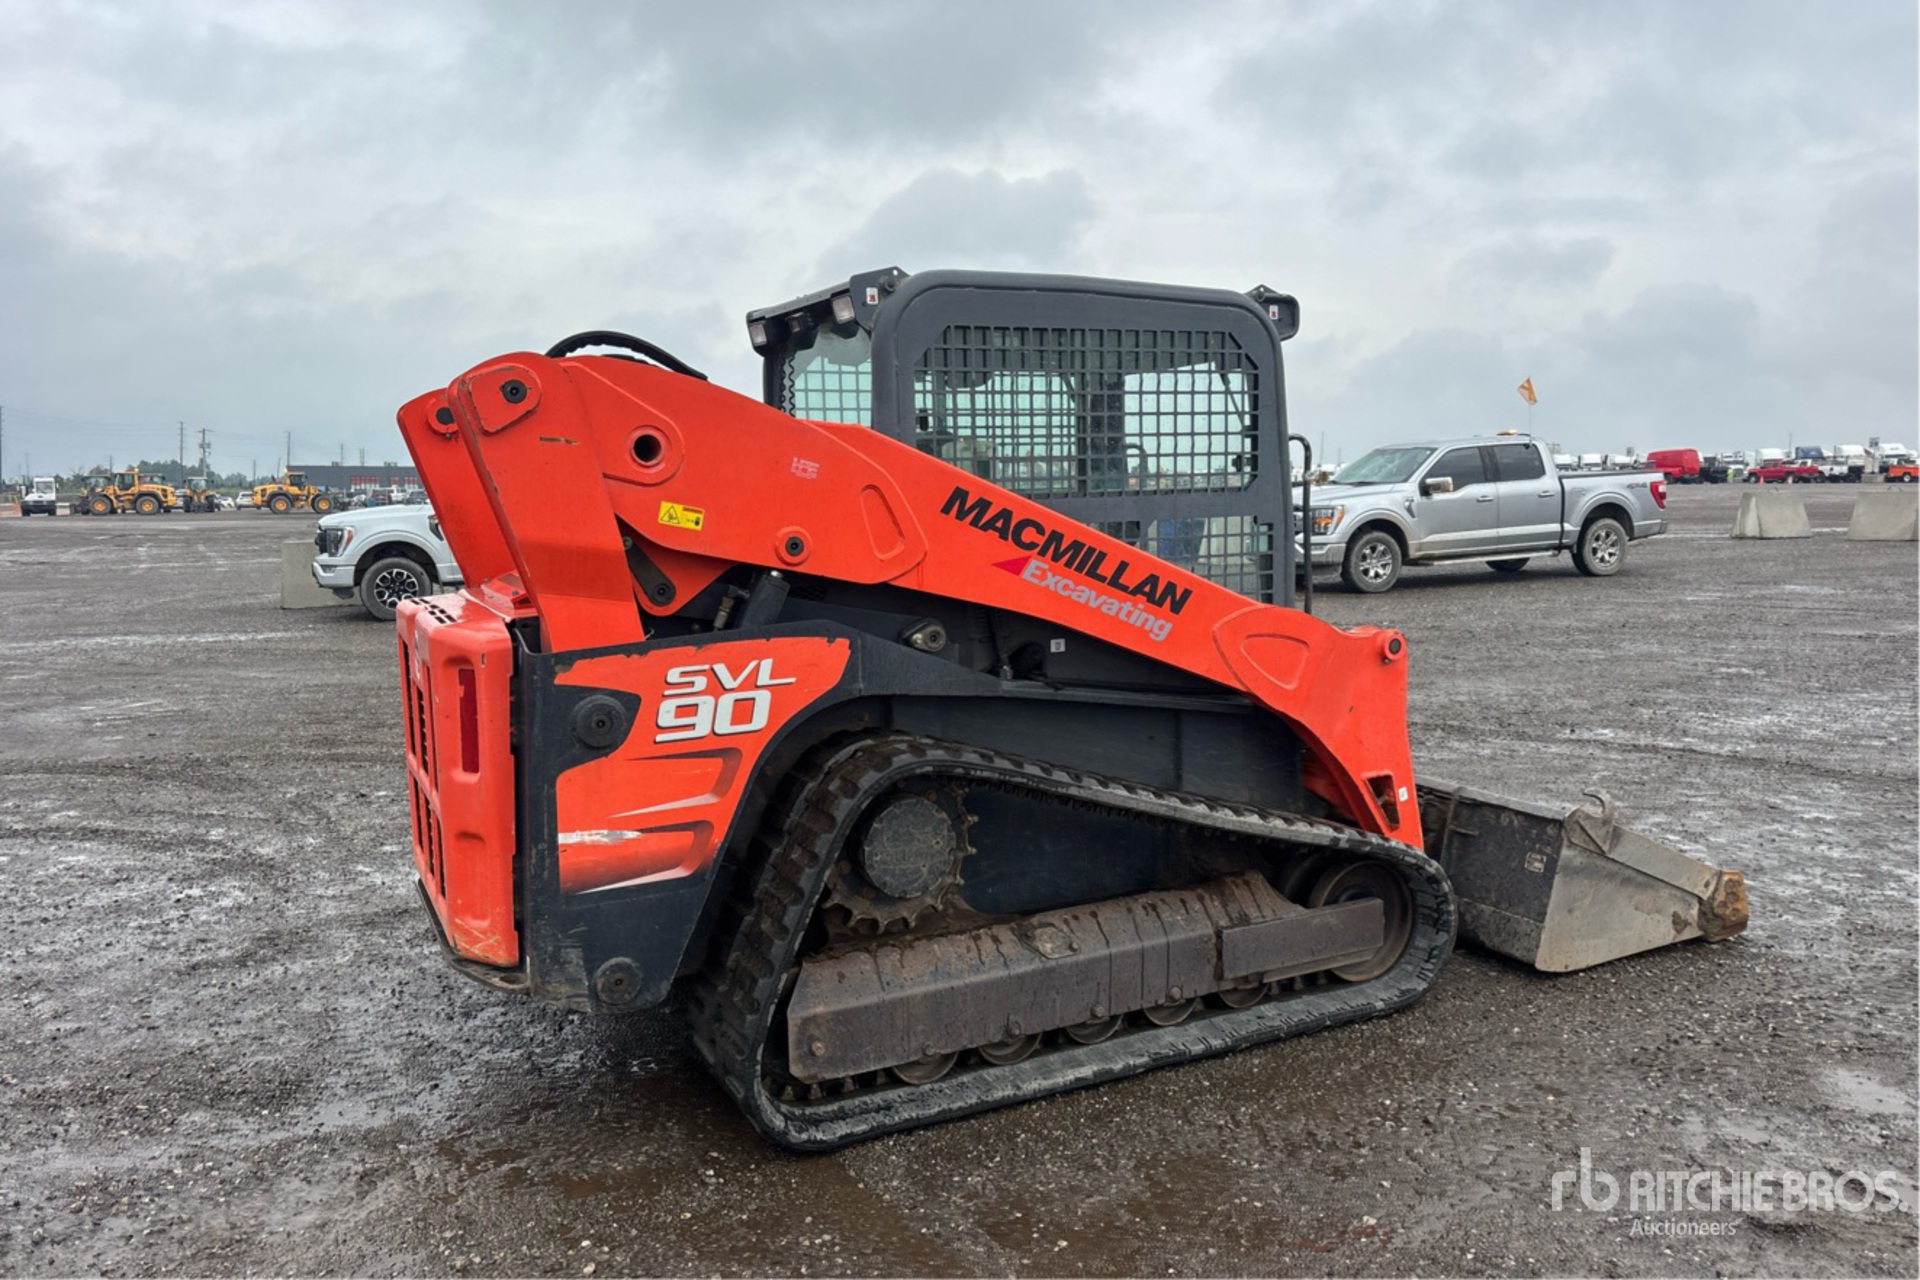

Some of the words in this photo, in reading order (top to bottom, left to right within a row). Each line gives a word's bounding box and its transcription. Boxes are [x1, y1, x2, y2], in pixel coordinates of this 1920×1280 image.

[940, 486, 1193, 615] MACMILLAN
[1021, 559, 1173, 642] Excavating
[663, 658, 797, 696] SVL
[654, 690, 772, 743] 90
